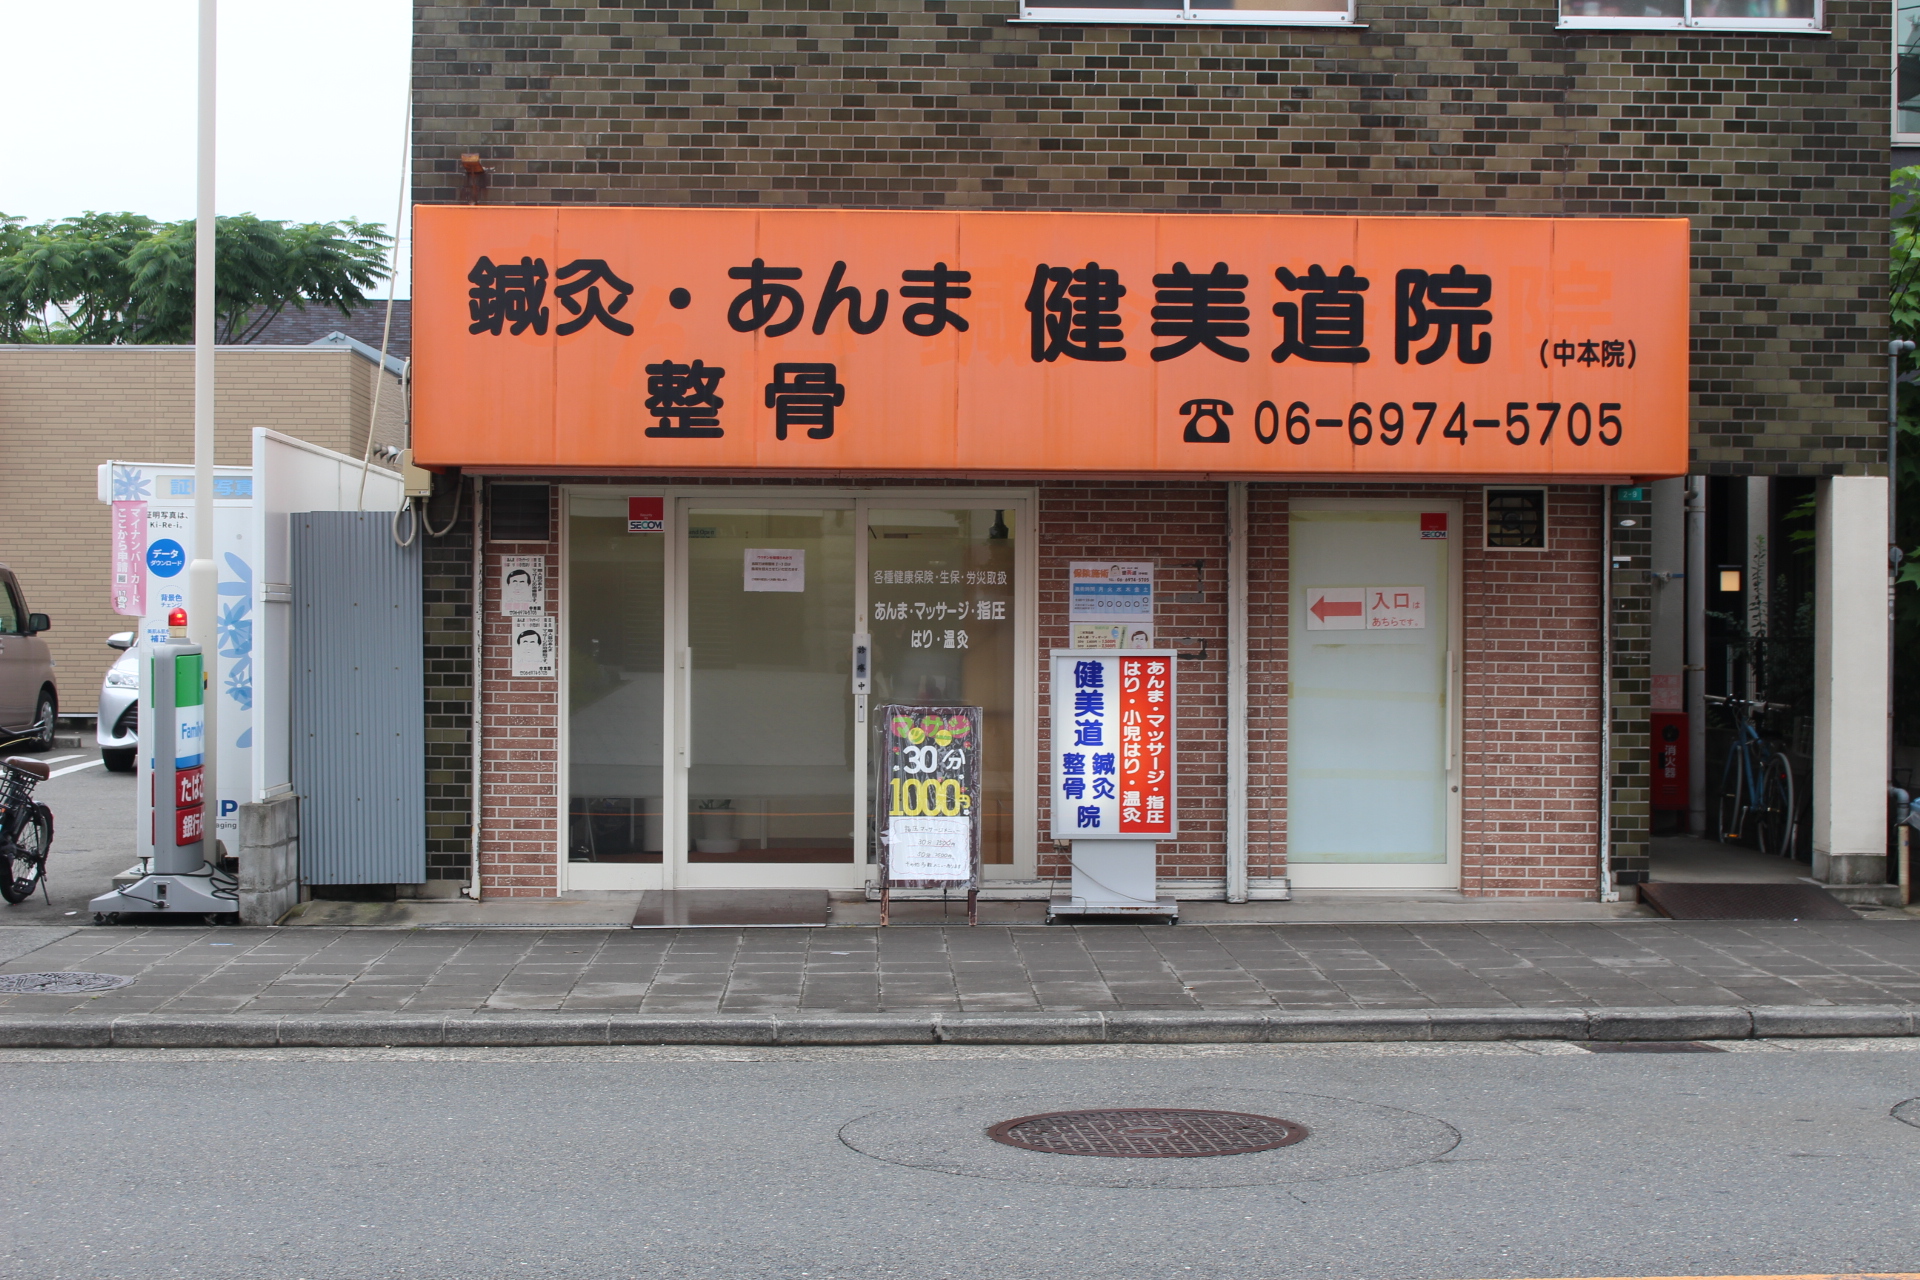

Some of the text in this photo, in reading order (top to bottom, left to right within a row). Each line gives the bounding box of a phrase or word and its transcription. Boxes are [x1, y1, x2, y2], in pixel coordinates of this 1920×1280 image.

[468, 255, 972, 338] 鍼灸・あんま
[1025, 261, 1493, 366] 健美道院
[644, 358, 846, 441] 整骨
[1254, 399, 1624, 447] 06-6974-5705
[1623, 490, 1638, 498] 2-9
[117, 508, 128, 573] ここから申請
[630, 521, 662, 530] SECOM
[131, 508, 141, 606] マイナンバーカード
[152, 548, 179, 558] データ
[874, 601, 1006, 621] あんま・マッサージ・指圧
[1371, 592, 1421, 611] 入口は
[1371, 616, 1419, 627] あちらです。
[911, 629, 970, 649] はり・温灸
[1073, 660, 1105, 747] 健美道
[903, 745, 966, 774] 30分
[1122, 661, 1142, 824] はり・小児はり・温灸
[1146, 661, 1166, 824] あんま・マッサージ・指圧
[1664, 744, 1677, 778] 消火器
[1062, 752, 1086, 801] 整骨
[1092, 752, 1116, 801] 鍼灸
[1077, 804, 1101, 829] 院
